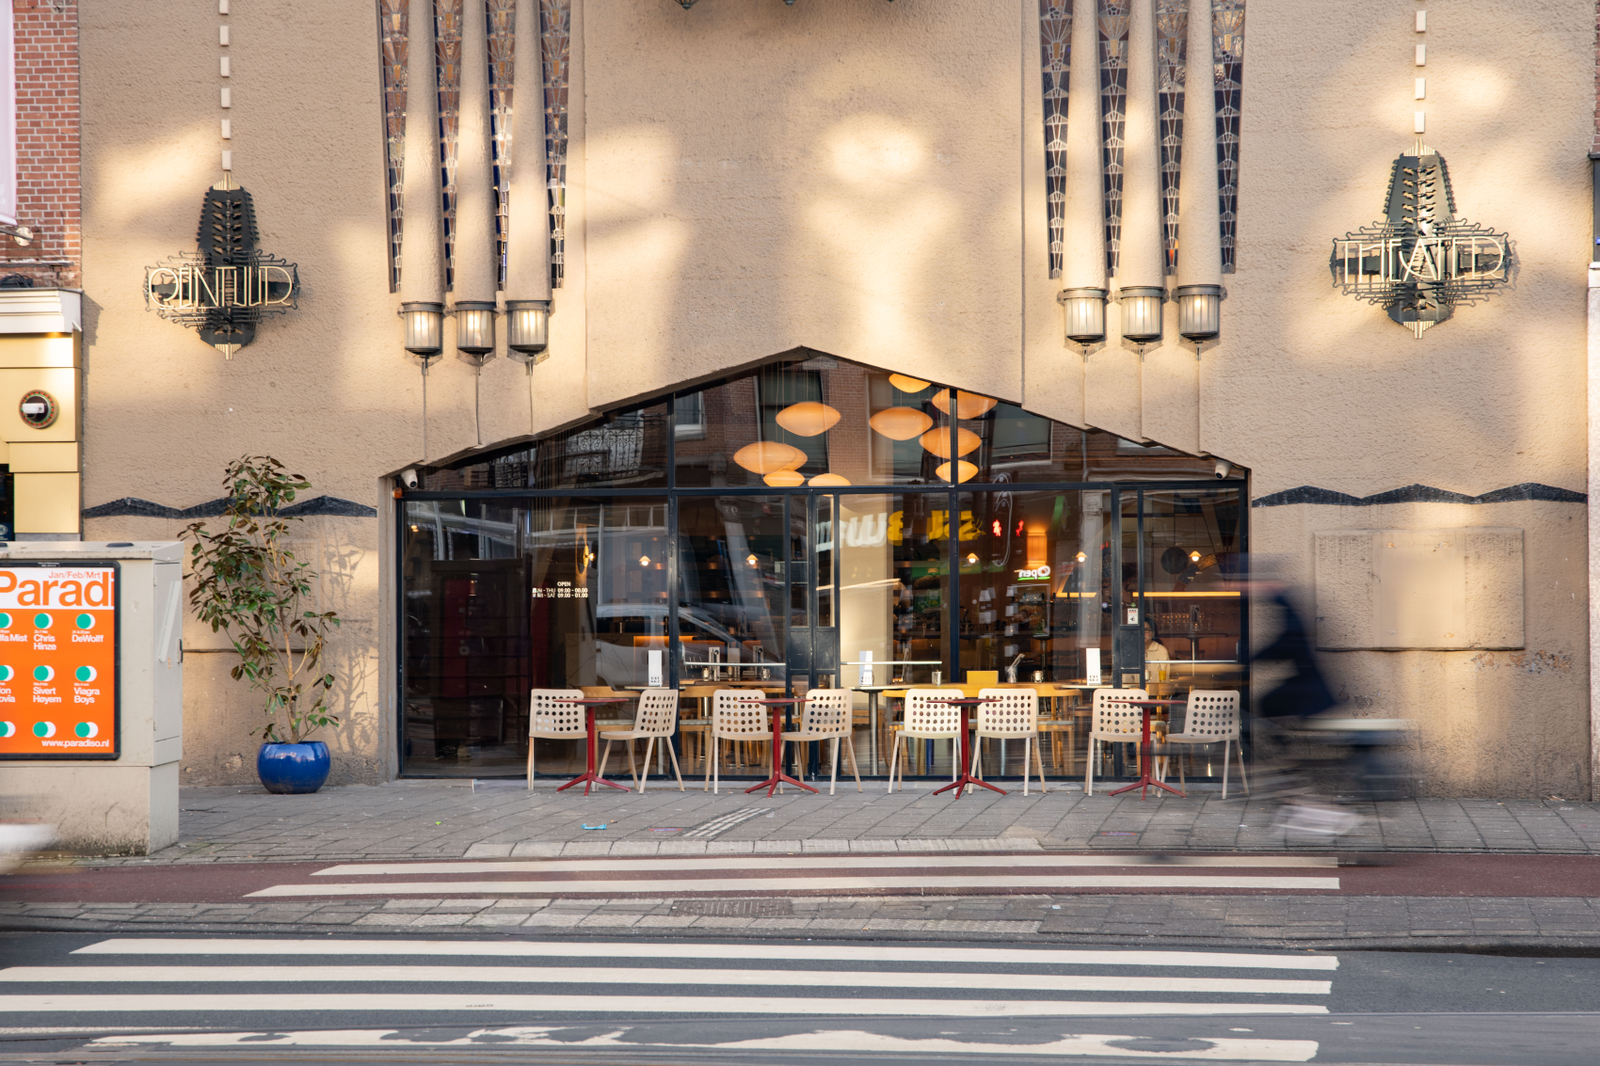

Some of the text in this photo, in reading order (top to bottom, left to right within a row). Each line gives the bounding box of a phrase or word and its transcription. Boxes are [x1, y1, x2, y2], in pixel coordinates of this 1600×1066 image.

[1337, 237, 1504, 283] THEATER
[48, 571, 101, 579] Jan/Feb/Mrt
[9, 633, 28, 642] Mist
[33, 634, 56, 642] Chris
[71, 634, 104, 643] DeWolff
[33, 642, 57, 651] Hinze
[33, 686, 57, 695] Sivert
[73, 687, 100, 697] Viagra
[74, 695, 96, 705] Boys
[41, 739, 110, 748] www.paradiso.nl
